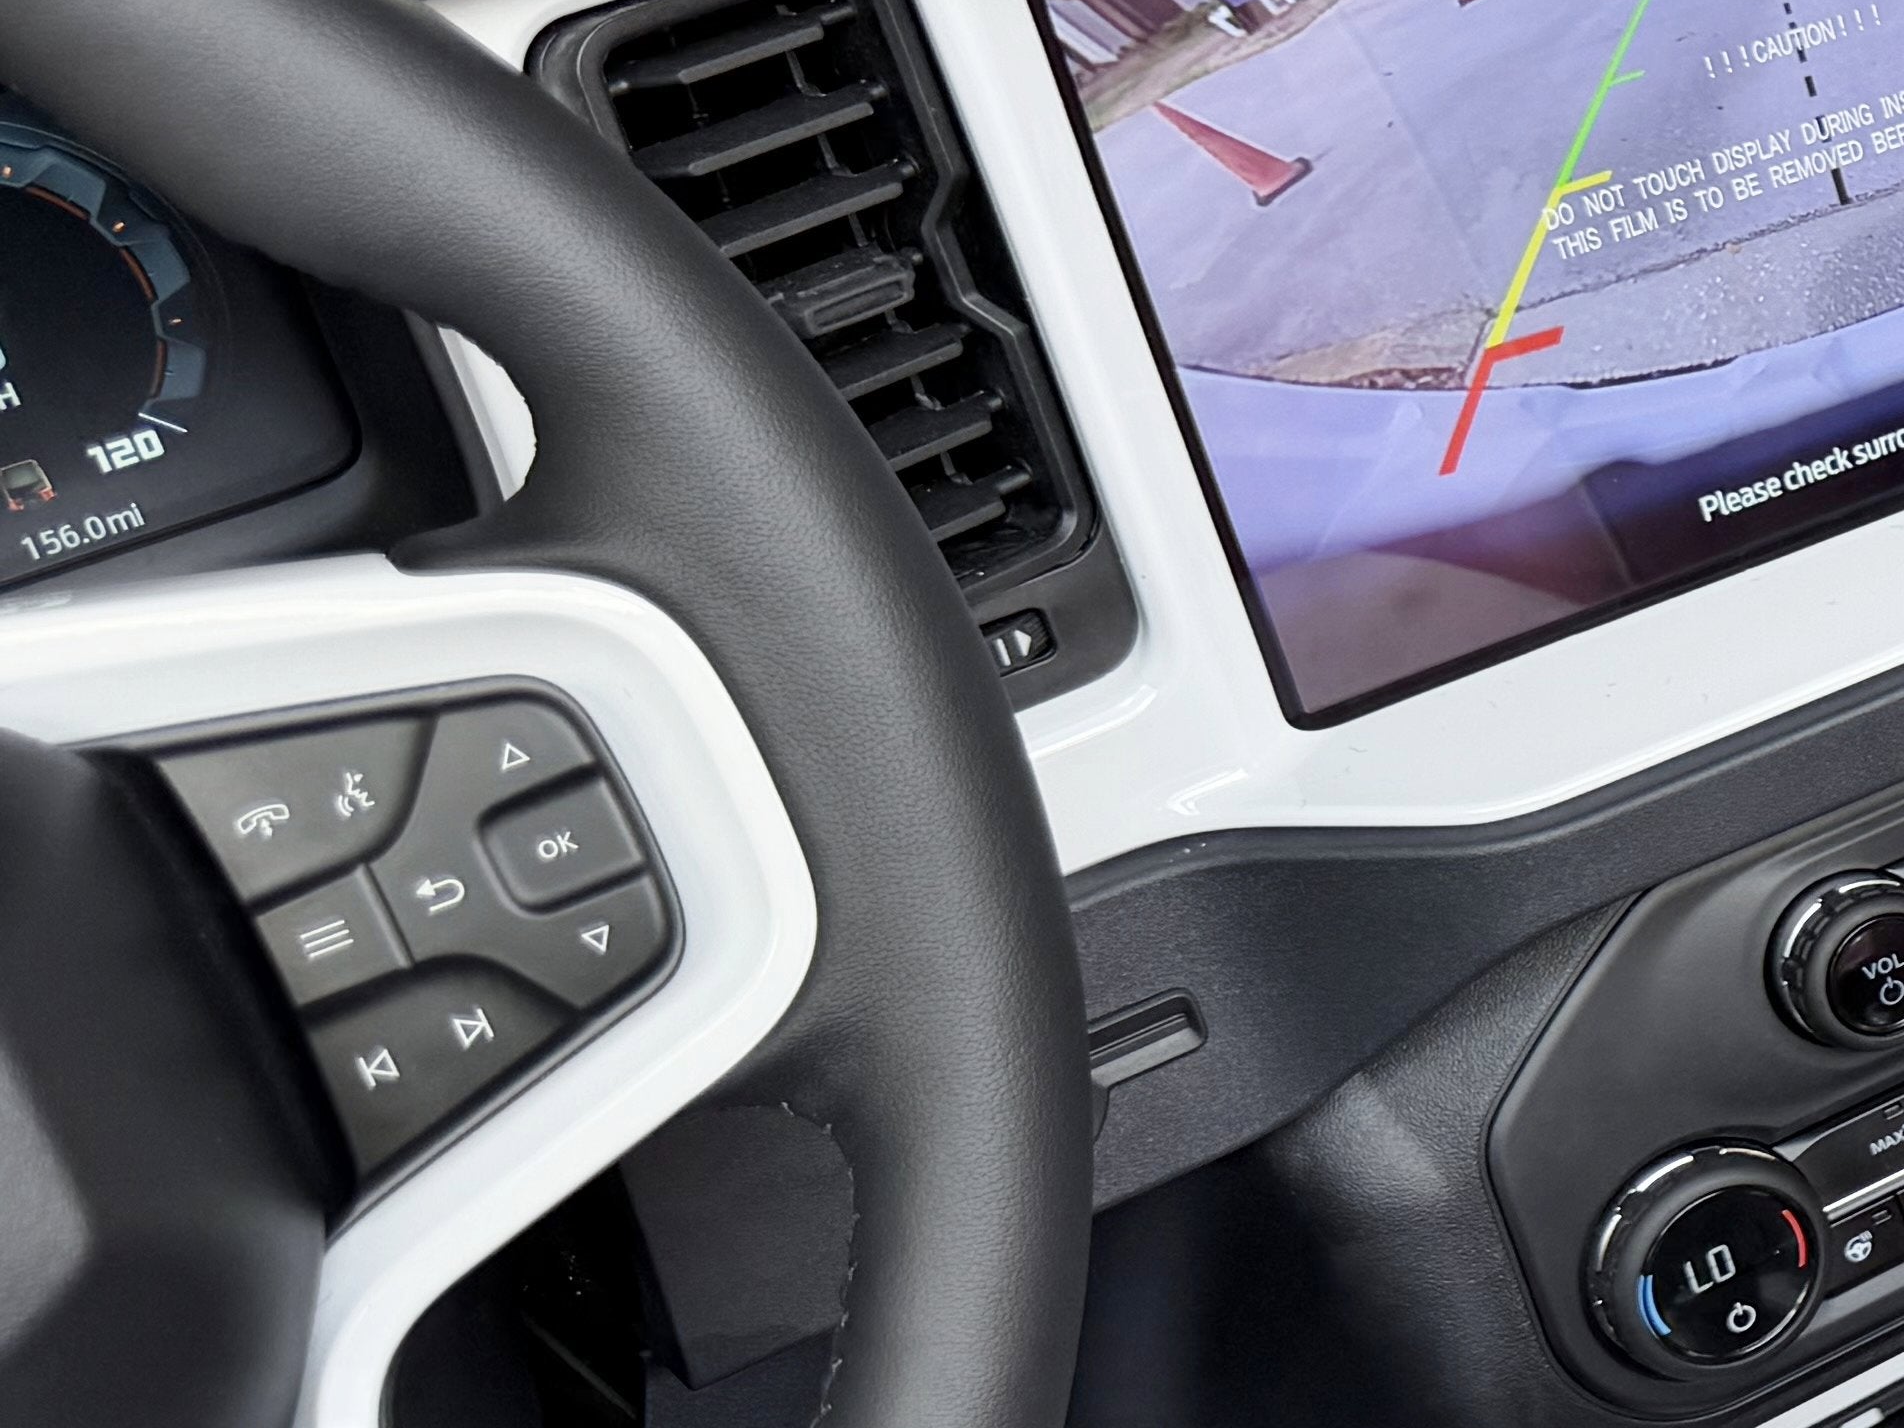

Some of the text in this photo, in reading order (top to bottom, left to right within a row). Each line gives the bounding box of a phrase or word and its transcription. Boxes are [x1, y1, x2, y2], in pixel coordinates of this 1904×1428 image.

[1542, 196, 1575, 232] DO
[1585, 186, 1626, 219] NOT
[1632, 158, 1705, 201] TOUCH
[1712, 130, 1791, 175] DISPLAY
[1801, 104, 1874, 146] DURING
[1552, 227, 1602, 260] THIS
[1609, 207, 1659, 242] FILM
[1664, 198, 1688, 222] IS
[1694, 185, 1726, 213] TO
[1734, 173, 1765, 202] BE
[1769, 140, 1863, 189] REMOVED
[86, 429, 165, 475] 120
[1698, 473, 1783, 522] Please
[1783, 447, 1854, 492] check
[538, 831, 579, 858] OK
